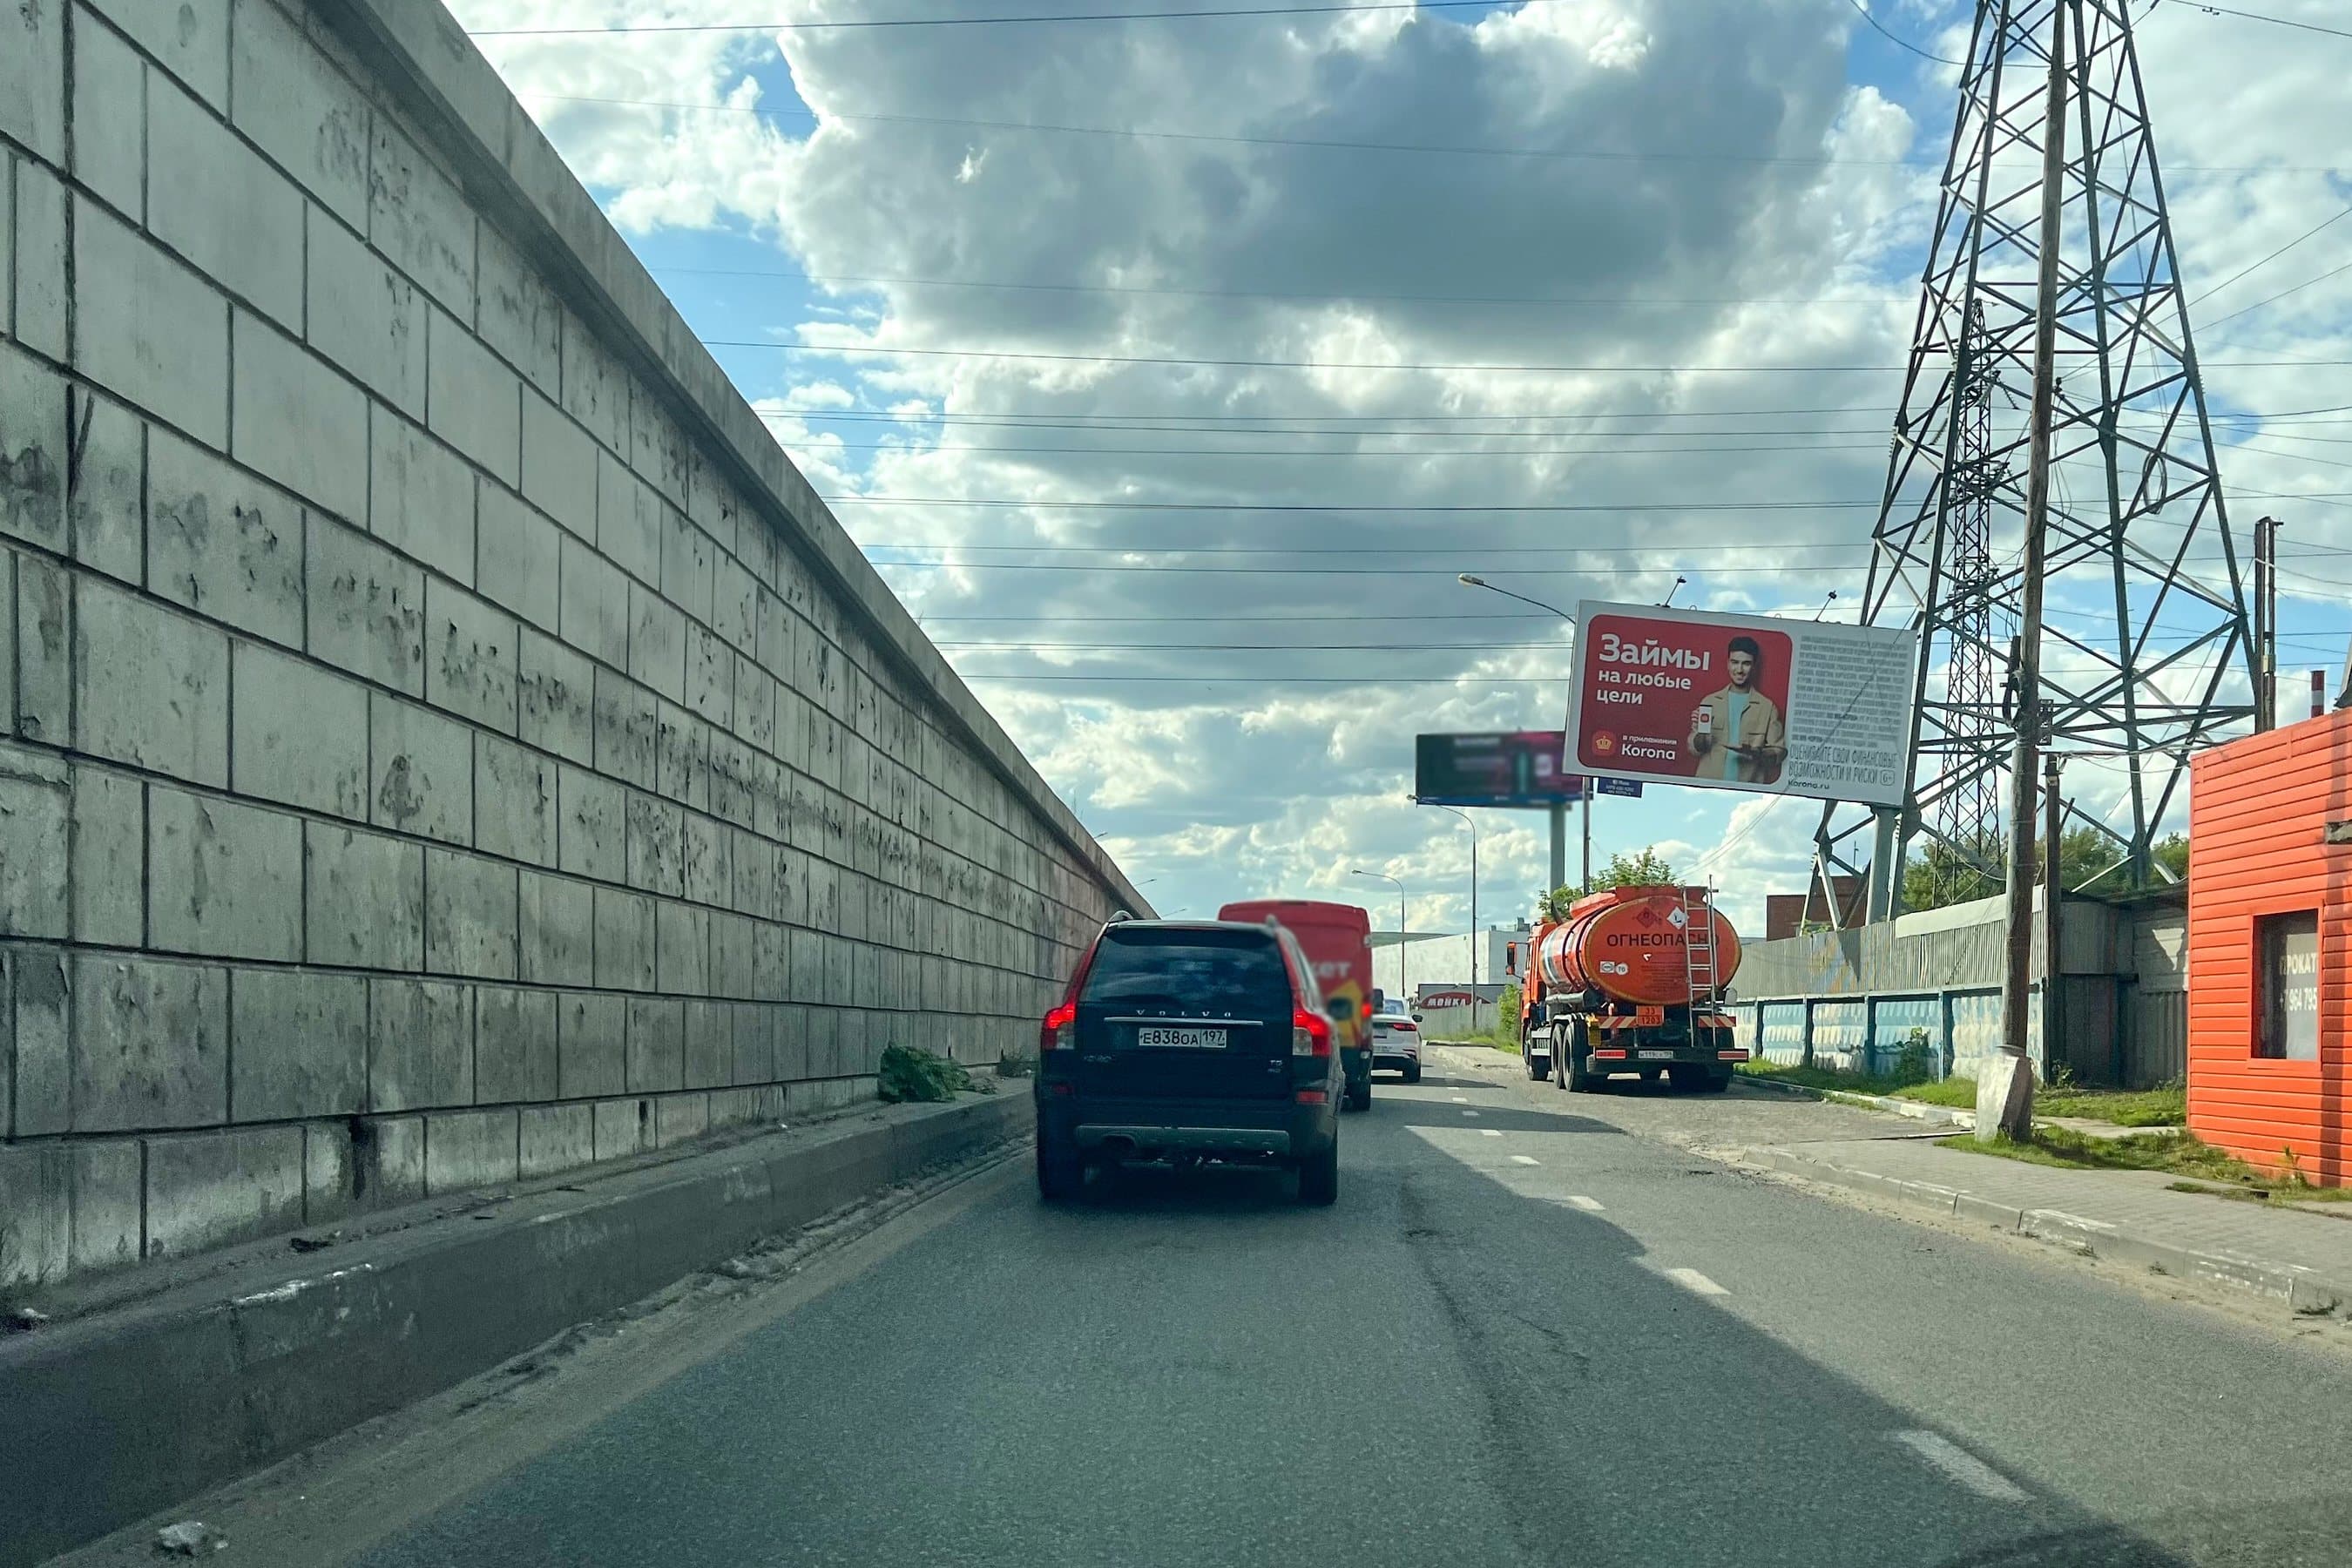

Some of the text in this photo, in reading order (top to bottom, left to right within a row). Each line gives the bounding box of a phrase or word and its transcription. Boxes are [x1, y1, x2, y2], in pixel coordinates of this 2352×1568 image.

[1598, 633, 1710, 671] Займы
[1598, 670, 1692, 690] на любые
[1596, 689, 1643, 705] цели
[1621, 744, 1676, 760] Korona
[1788, 780, 1830, 790] Korona.ru
[2279, 952, 2317, 975] ПРОКАТ
[1427, 996, 1467, 1007] МОЙКА
[1137, 1009, 1231, 1017] VOLVO
[1203, 1031, 1222, 1042] 197
